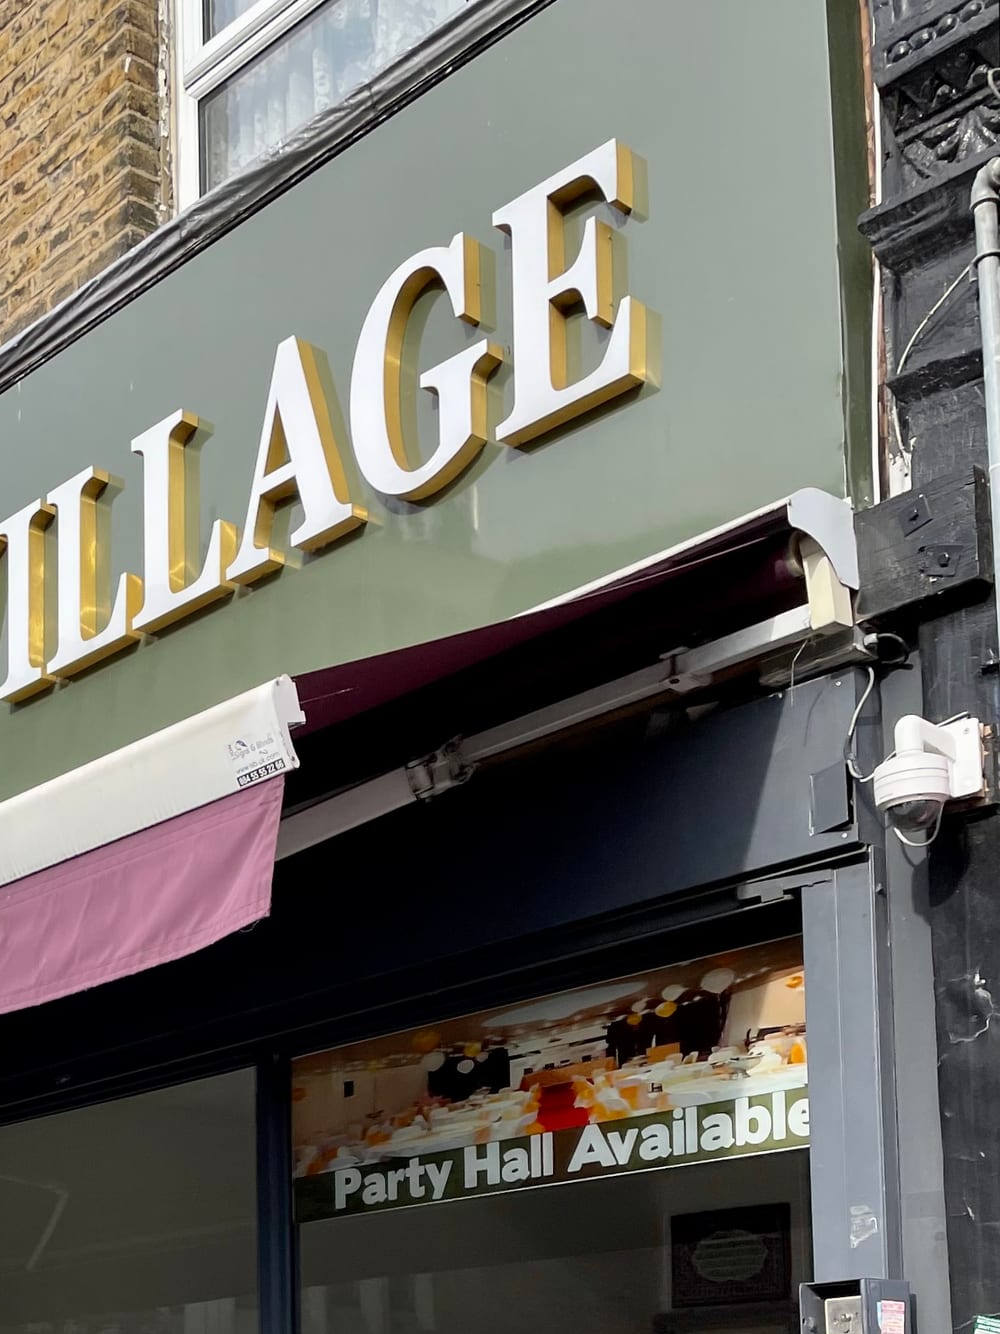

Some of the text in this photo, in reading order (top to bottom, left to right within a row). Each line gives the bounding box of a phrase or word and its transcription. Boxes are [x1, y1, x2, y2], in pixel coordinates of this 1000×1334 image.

[334, 1090, 811, 1211] Party Hall Available
